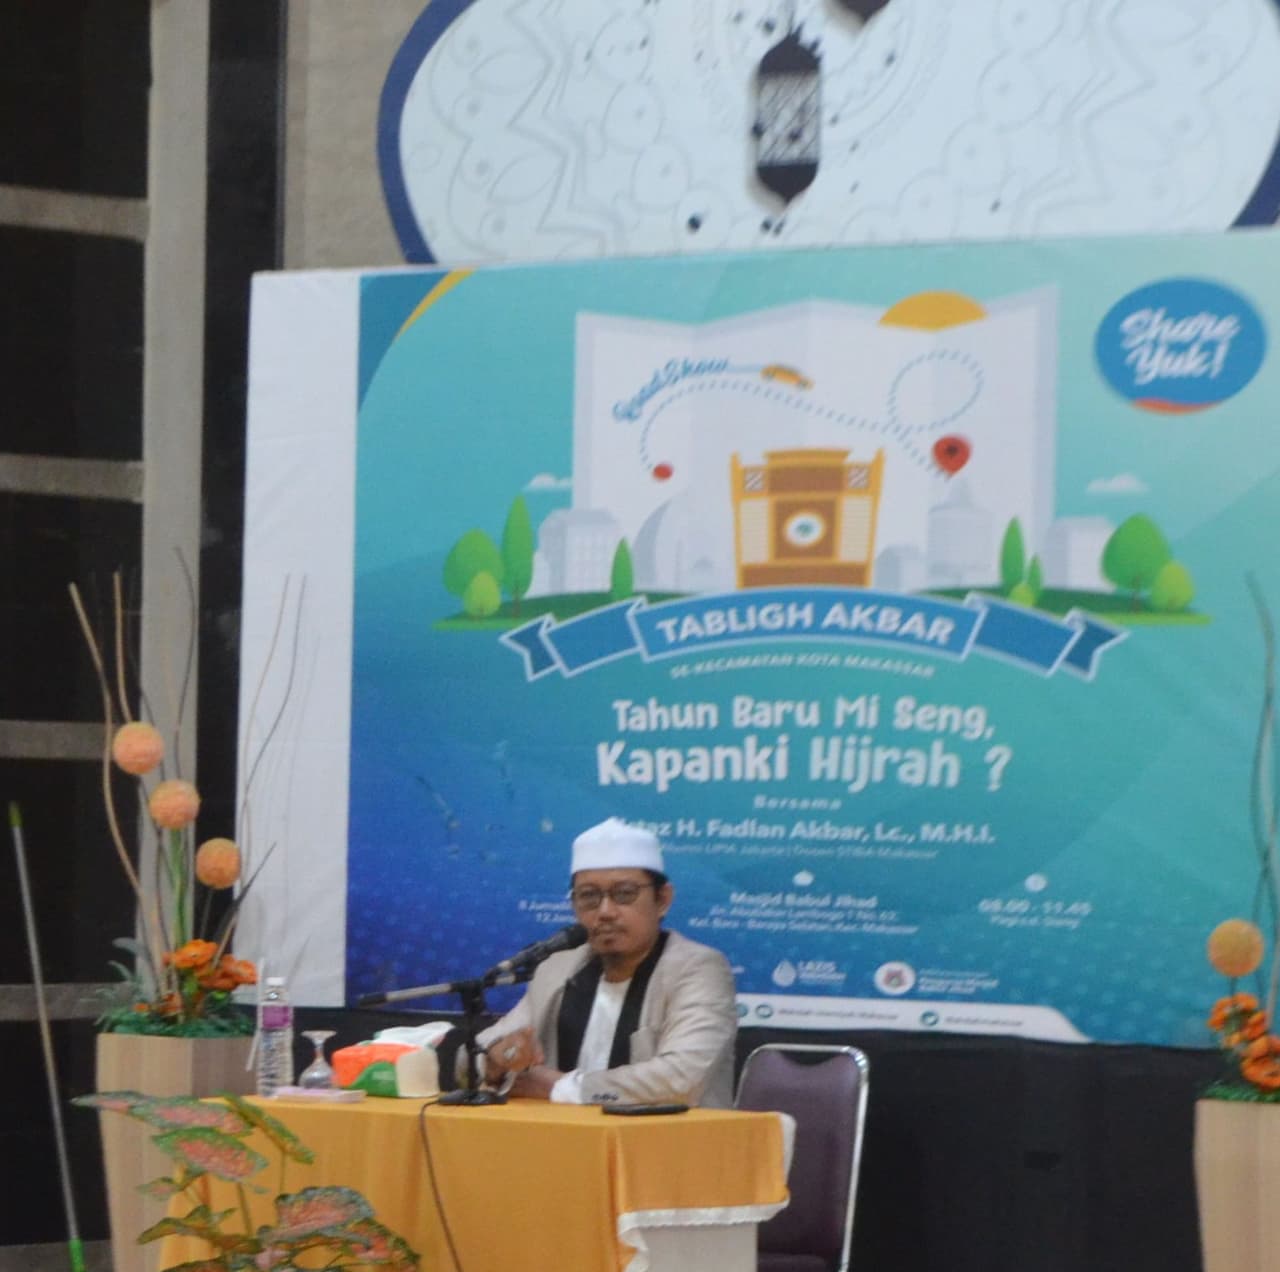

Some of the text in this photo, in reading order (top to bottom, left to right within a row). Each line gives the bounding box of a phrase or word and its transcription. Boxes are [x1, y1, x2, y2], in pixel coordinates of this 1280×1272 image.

[1120, 306, 1240, 349] Share
[656, 602, 955, 645] TABLIGH AKBAR
[612, 695, 995, 740] Tahun Baru Mi Seng,
[596, 735, 1012, 793] Kapanki Hijrah ?
[753, 794, 842, 811] Bersama
[677, 818, 700, 838] H.
[707, 818, 786, 839] Fadlan
[790, 820, 871, 843] Akbar,
